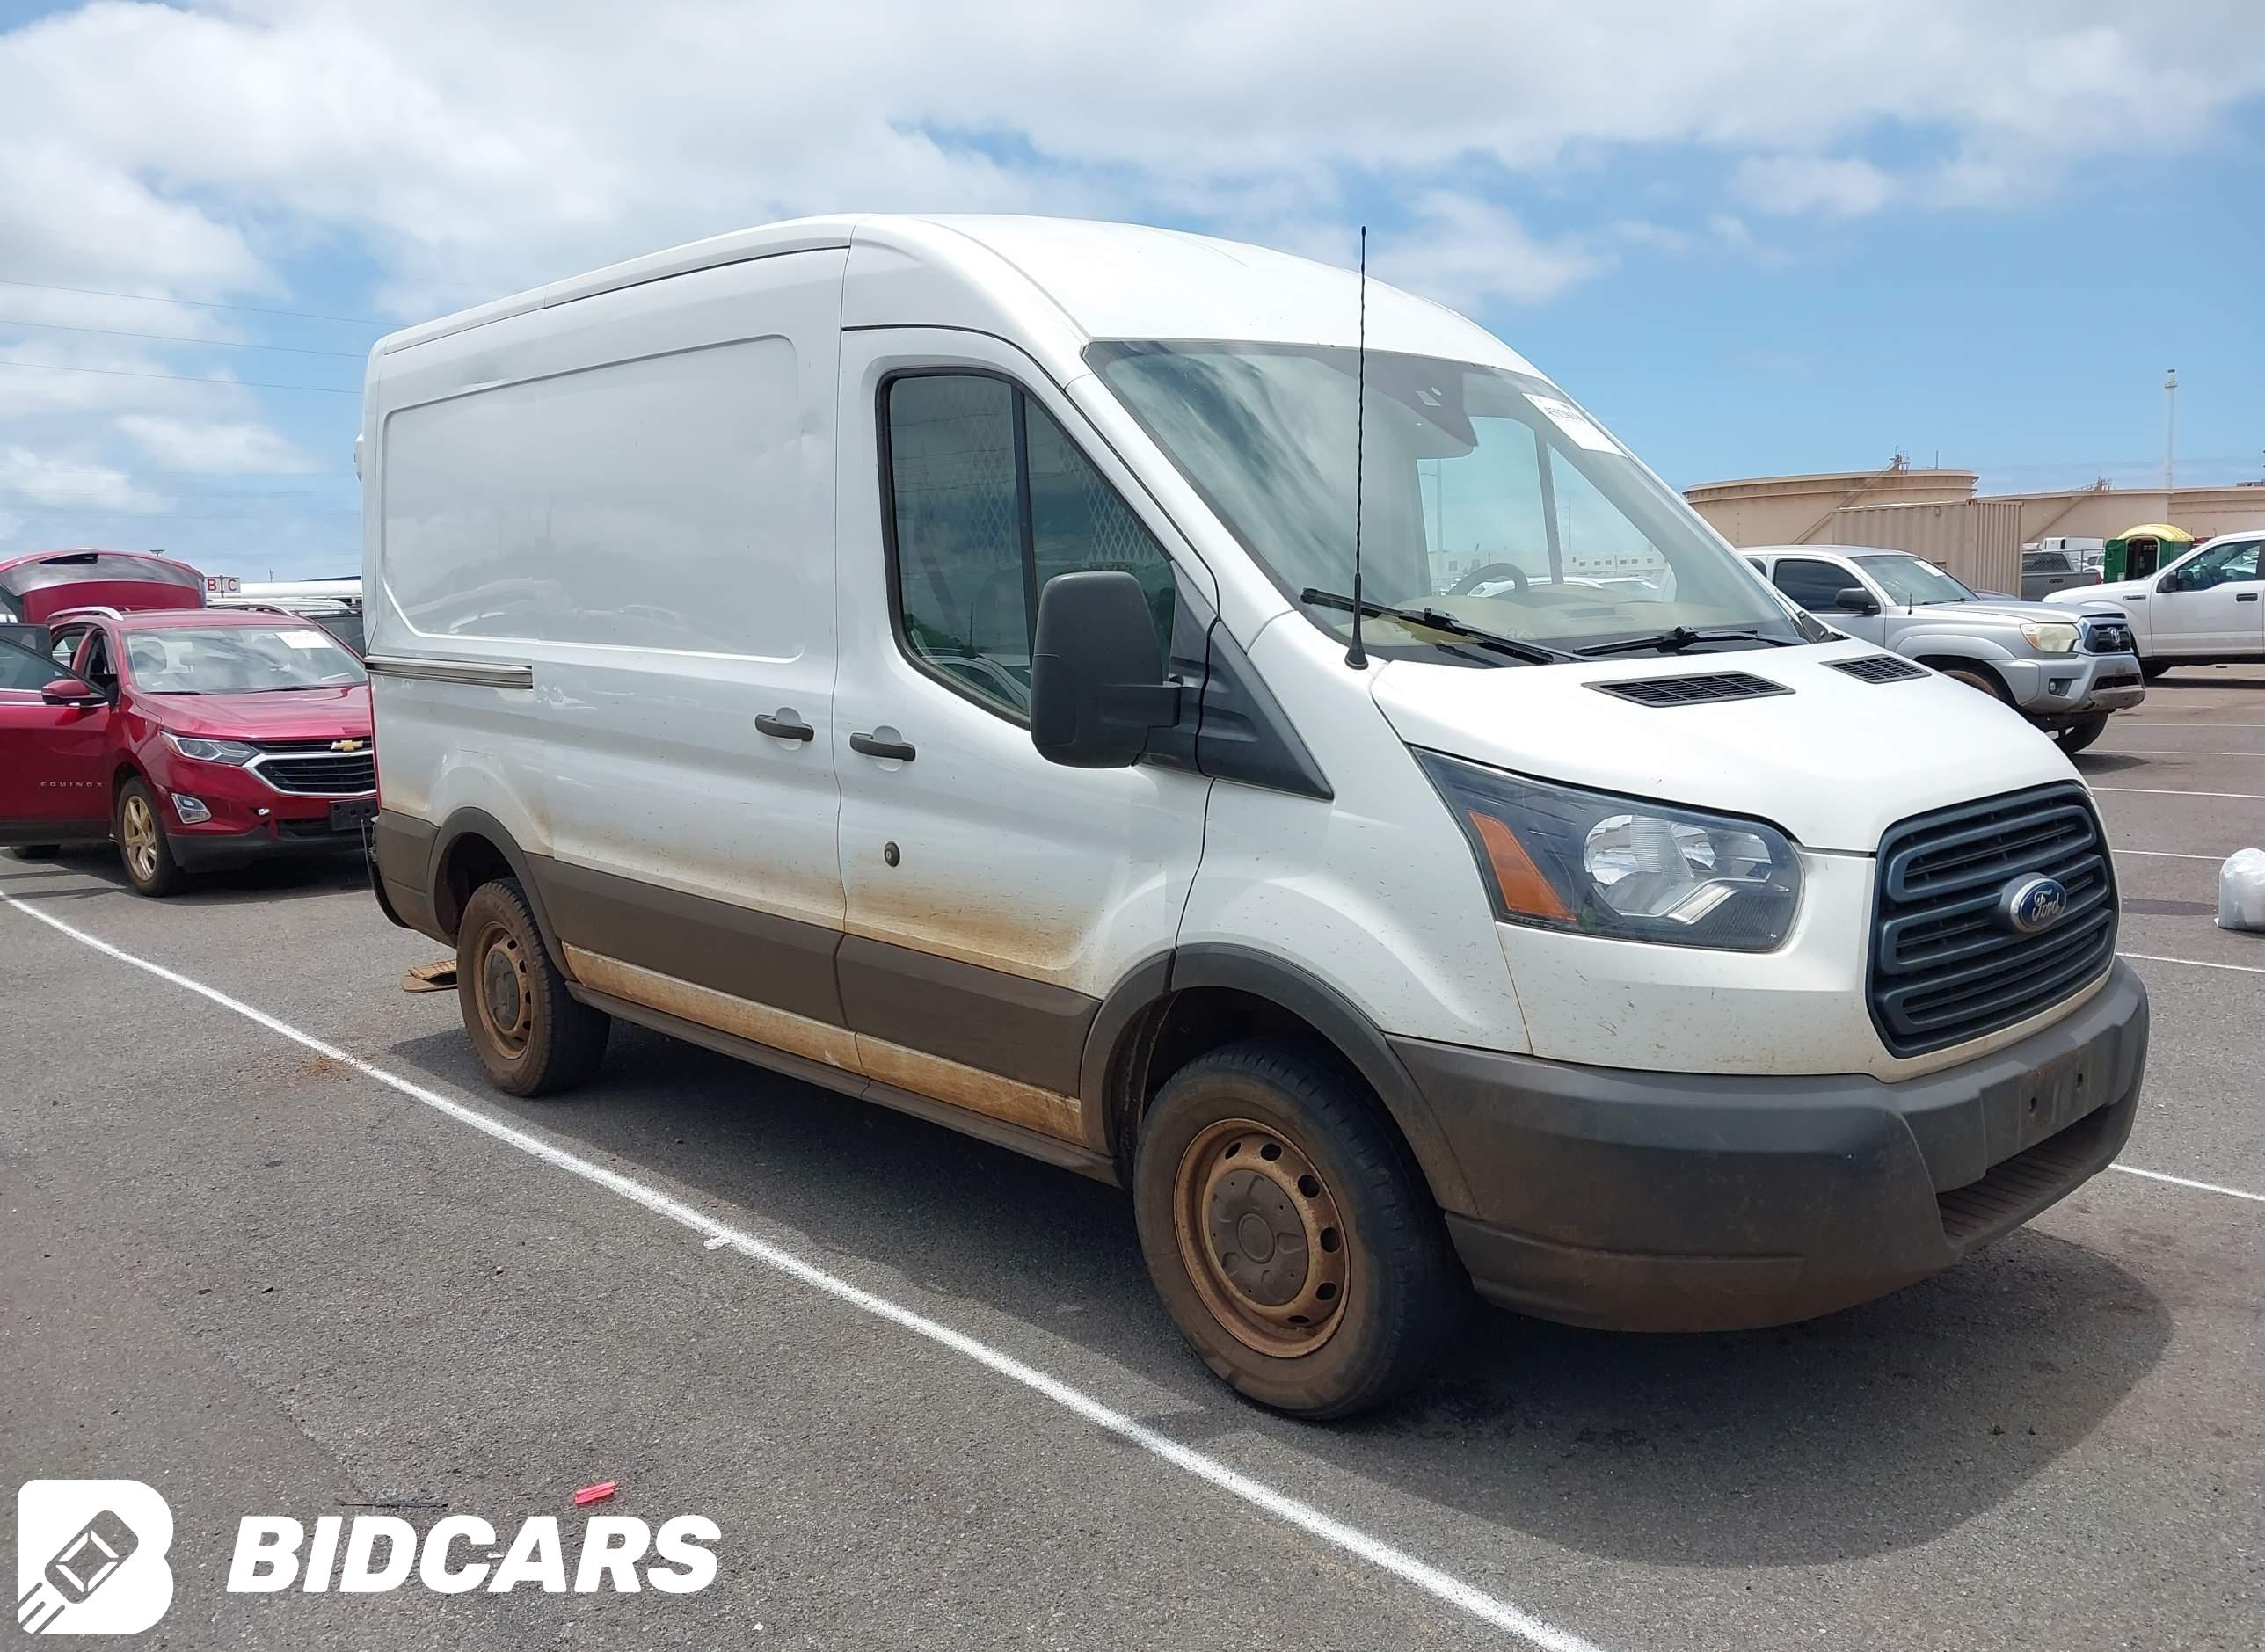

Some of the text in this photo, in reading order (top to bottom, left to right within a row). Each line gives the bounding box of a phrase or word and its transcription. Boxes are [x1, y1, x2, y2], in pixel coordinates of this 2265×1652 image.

[207, 579, 217, 592] B
[228, 579, 237, 592] C
[2032, 889, 2060, 921] Ford
